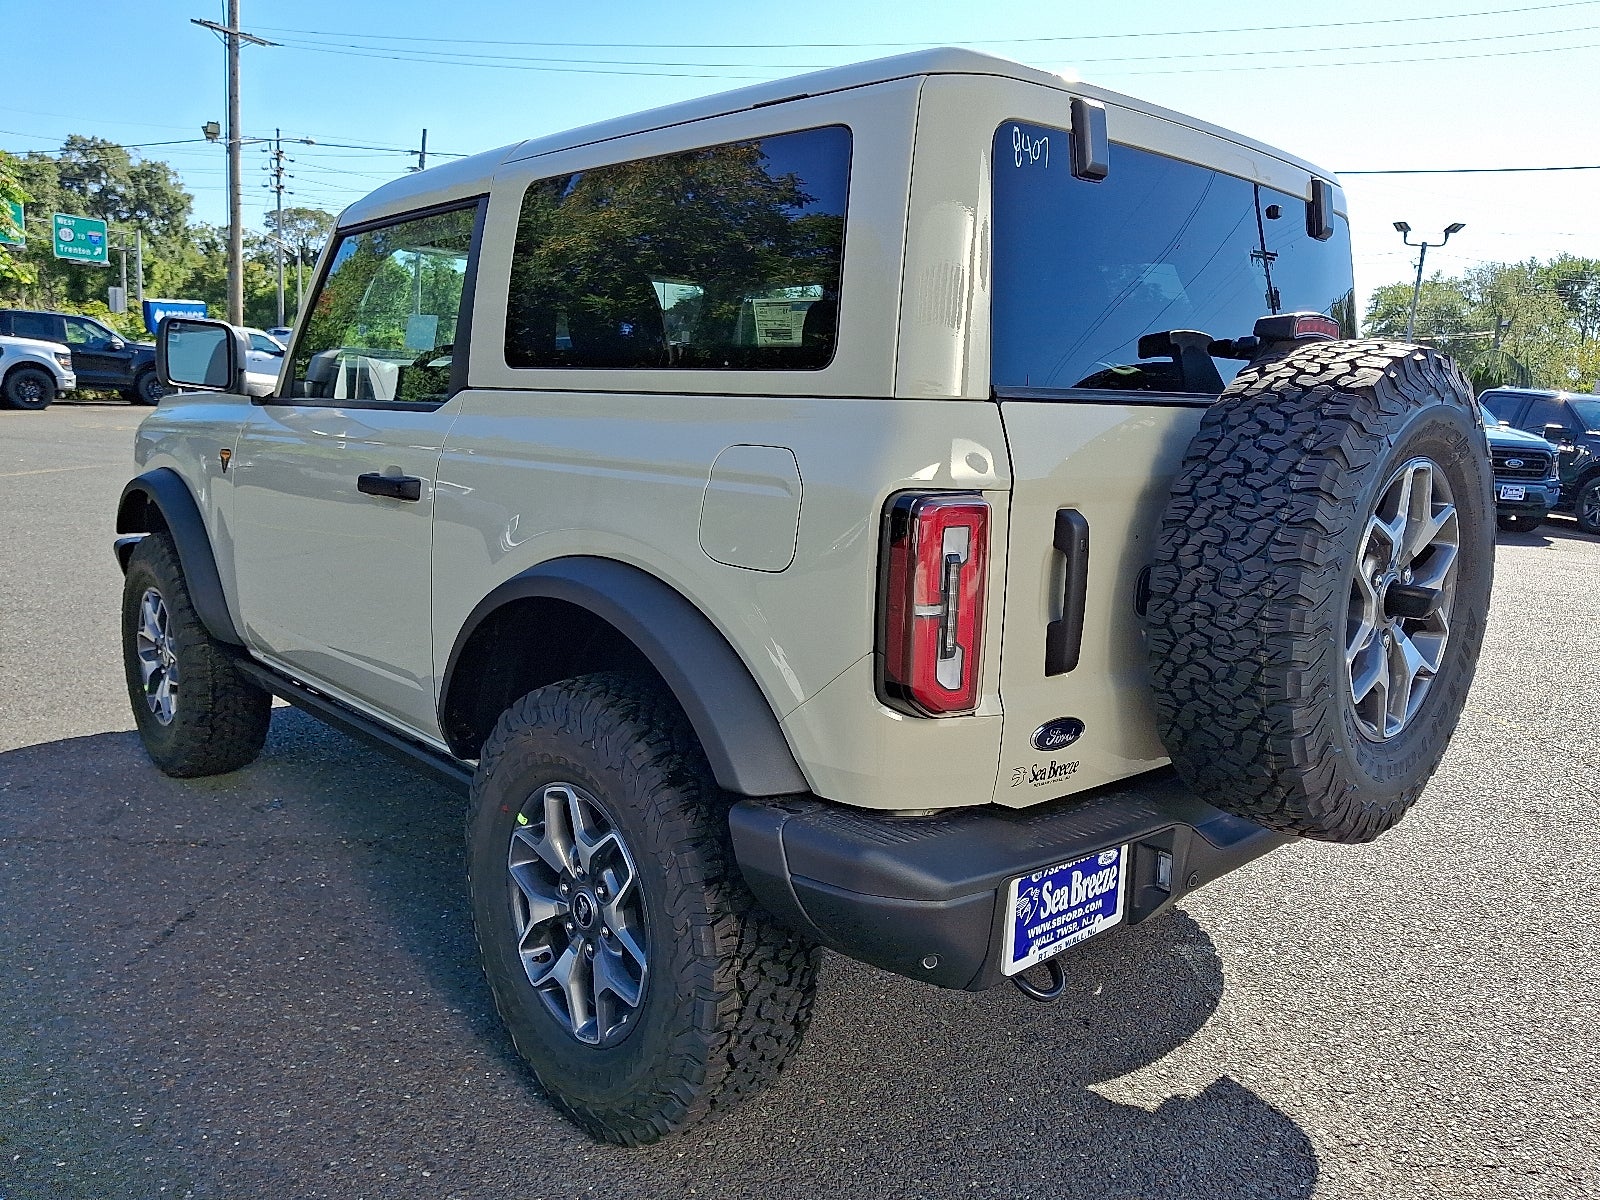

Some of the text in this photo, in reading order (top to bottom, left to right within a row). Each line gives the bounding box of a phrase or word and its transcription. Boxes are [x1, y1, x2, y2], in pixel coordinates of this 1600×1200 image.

[1012, 126, 1050, 169] 8407
[57, 217, 76, 226] WEST
[59, 244, 91, 255] Trenton
[1028, 763, 1047, 784] Sea
[1047, 760, 1080, 780] Breeze
[1040, 865, 1118, 919] Sea Breeze
[1027, 899, 1103, 939] WWW.SBFORD.COM
[1033, 932, 1054, 947] WALL
[1052, 944, 1063, 954] 35
